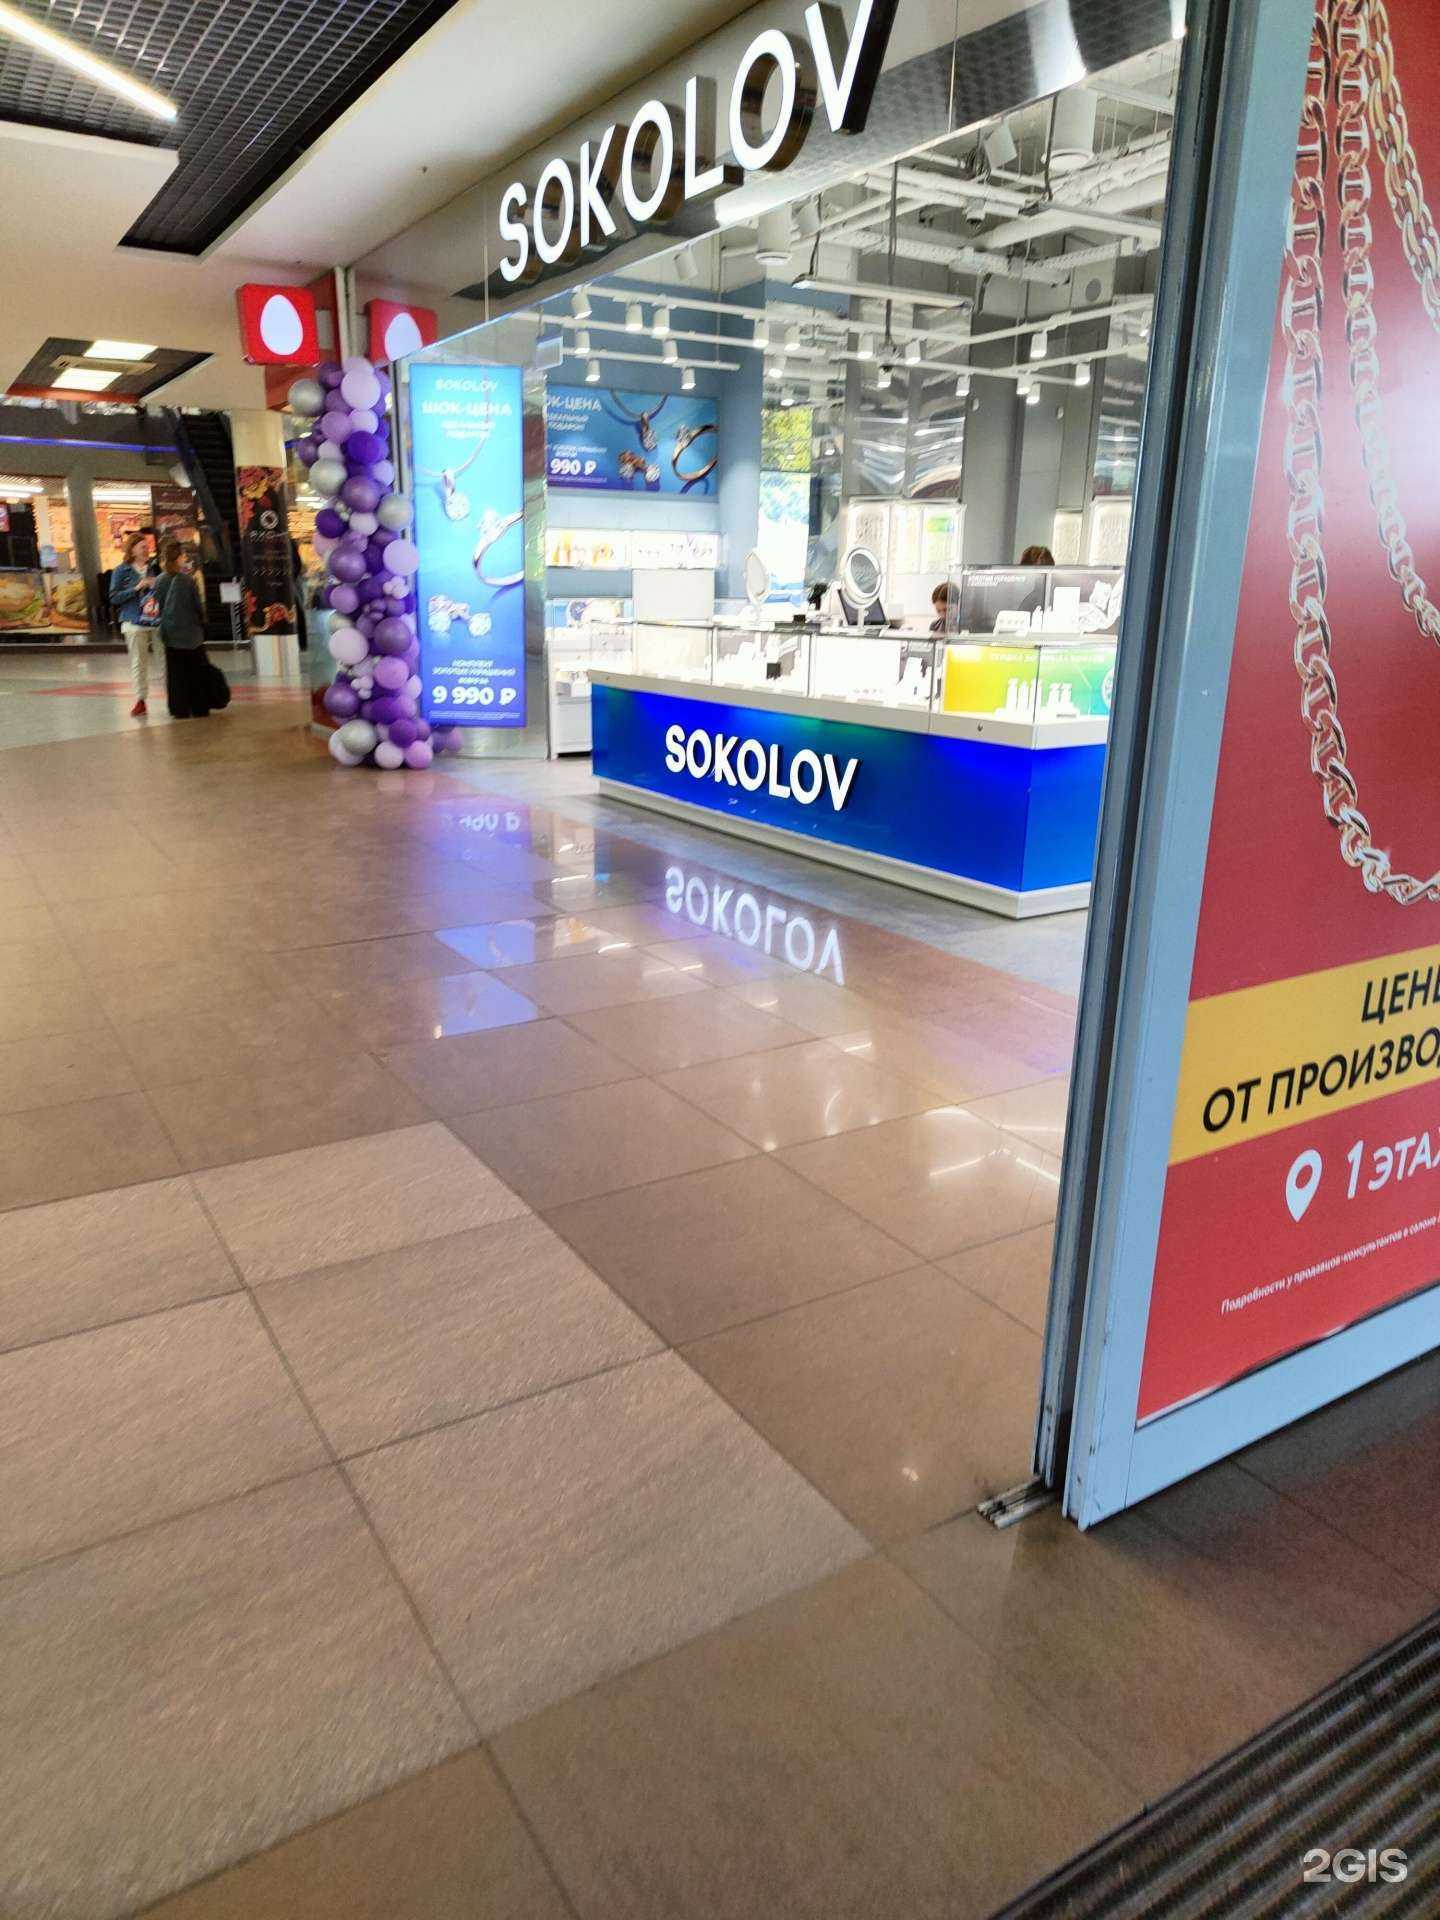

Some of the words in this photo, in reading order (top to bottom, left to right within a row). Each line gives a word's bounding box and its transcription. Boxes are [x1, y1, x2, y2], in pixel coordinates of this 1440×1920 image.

[500, 0, 878, 281] SOKOLOV
[434, 379, 498, 392] SOKOLOV
[421, 400, 512, 417] ШОК-ЦЕНА
[550, 458, 581, 475] 990
[432, 685, 447, 704] 9
[451, 686, 494, 705] 990
[665, 724, 859, 811] SOKOLOV
[1203, 1077, 1261, 1132] ОТ
[1267, 1027, 1440, 1115] ПРОИЗВО
[1347, 1139, 1364, 1200] 1
[1368, 1130, 1440, 1191] ЭТА
[1221, 1277, 1286, 1315] Подробности
